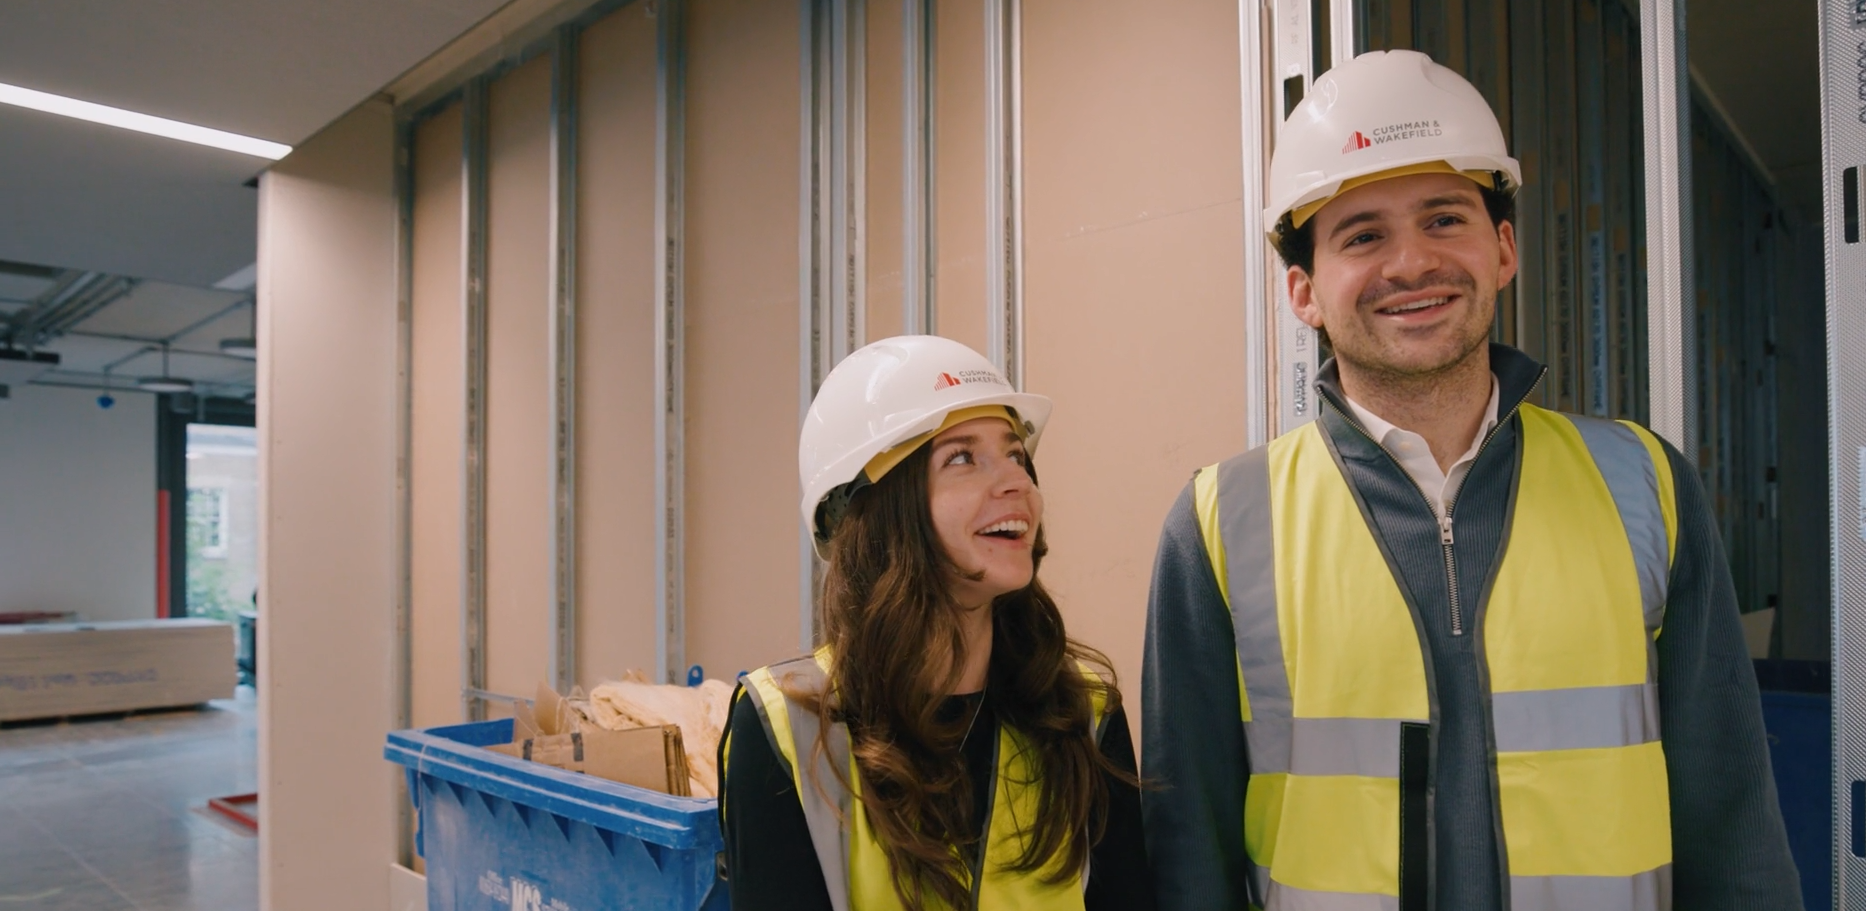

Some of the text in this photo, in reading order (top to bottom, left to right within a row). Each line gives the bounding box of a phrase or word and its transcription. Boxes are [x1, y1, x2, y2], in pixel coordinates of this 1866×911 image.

[1373, 120, 1440, 136] CUSHMAN &
[1374, 129, 1442, 145] WAKEFIELD
